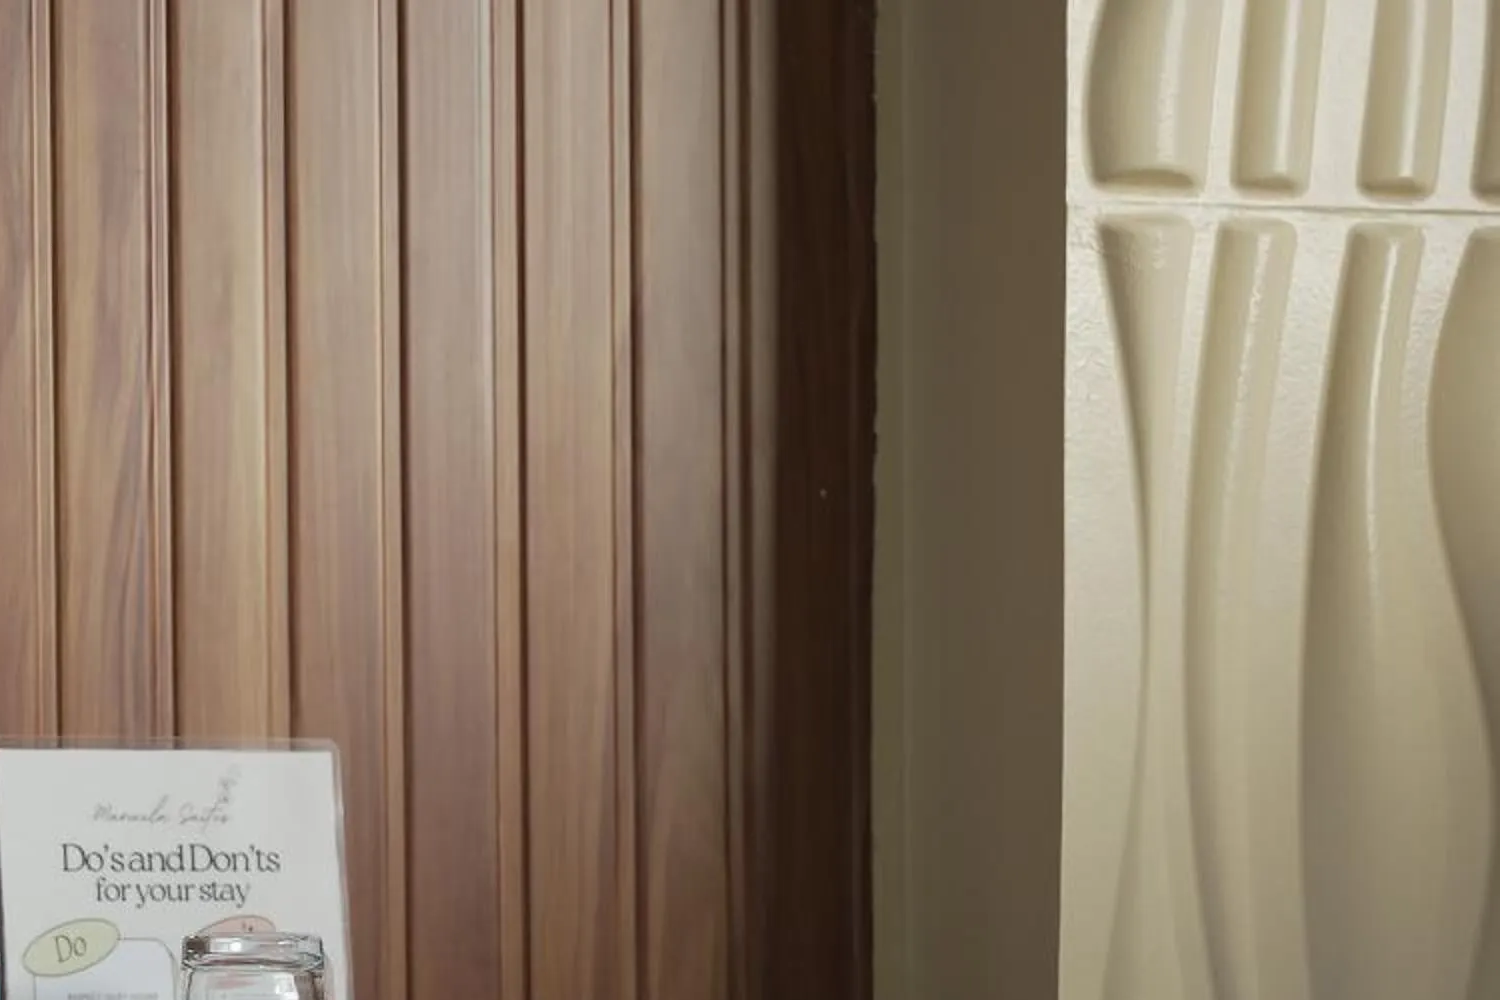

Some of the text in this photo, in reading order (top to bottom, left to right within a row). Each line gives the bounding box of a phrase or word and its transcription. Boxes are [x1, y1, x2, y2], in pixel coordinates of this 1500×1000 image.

[62, 843, 282, 873] Do's and Don'ts
[96, 877, 251, 909] for your stay
[53, 935, 87, 964] Do
